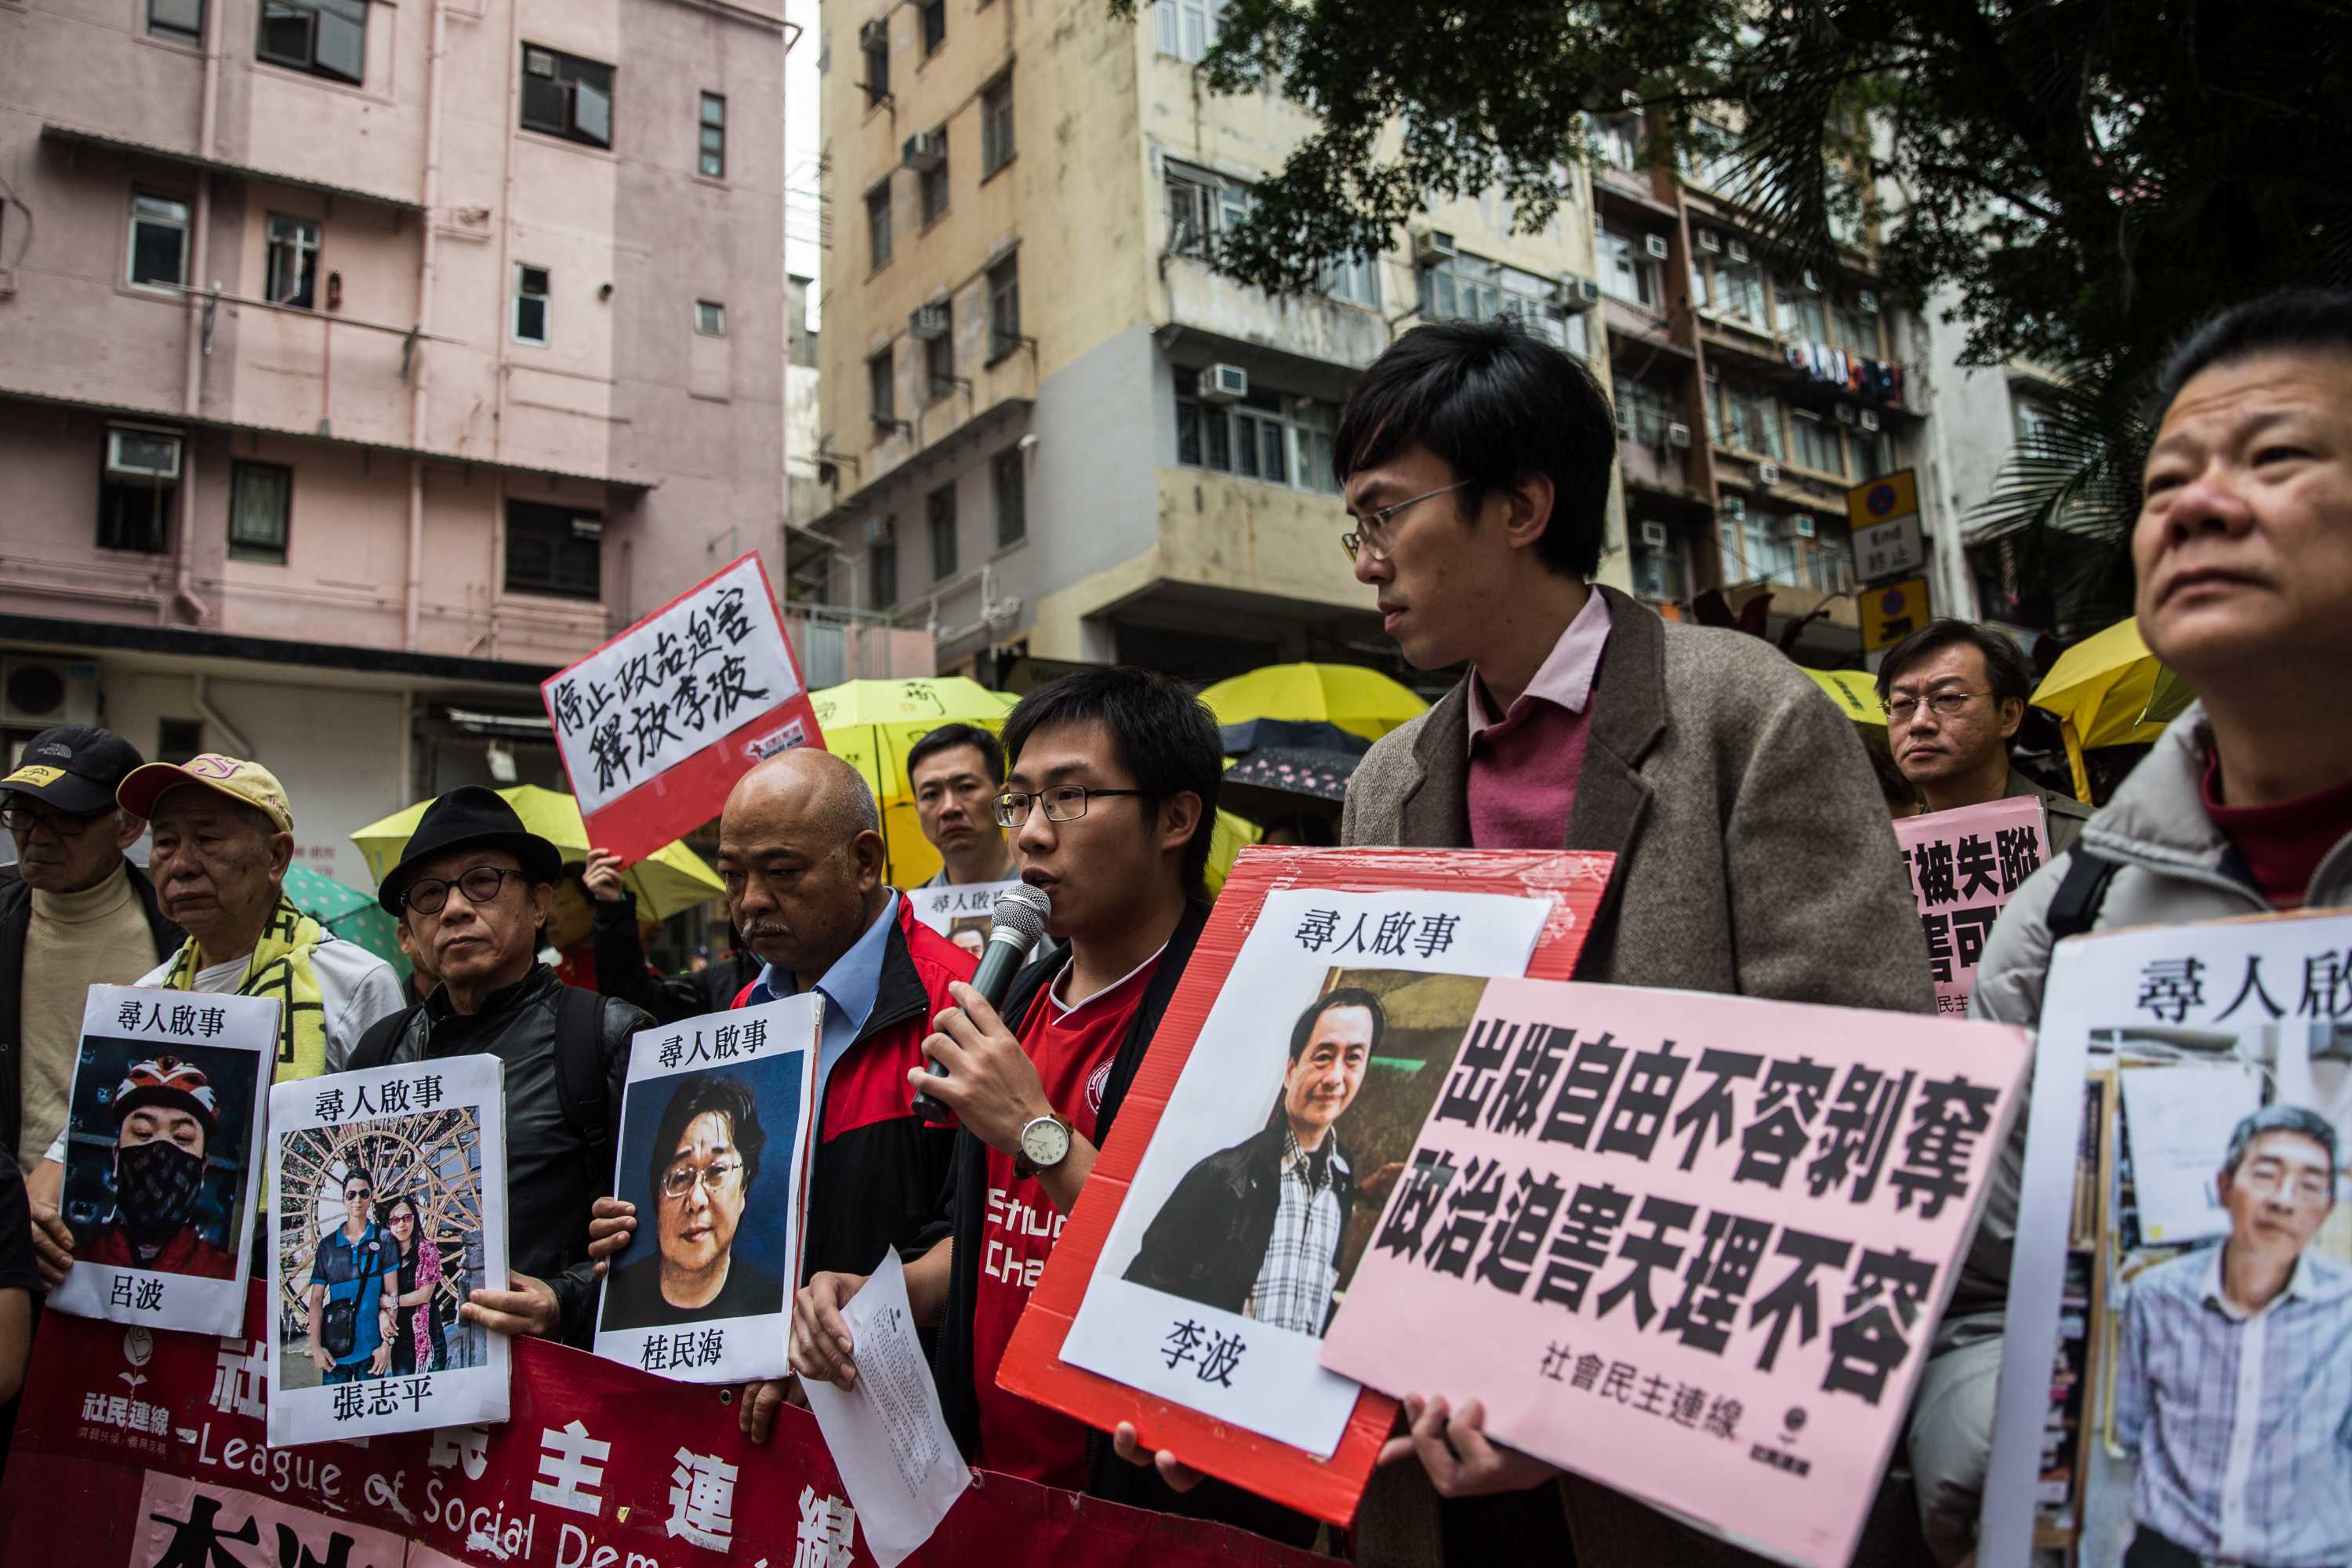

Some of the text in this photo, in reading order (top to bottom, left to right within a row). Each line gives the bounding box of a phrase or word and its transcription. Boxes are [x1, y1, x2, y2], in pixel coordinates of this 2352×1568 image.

[552, 586, 757, 738] 停止政治迫害
[587, 655, 769, 794] 釋放李波
[931, 890, 1004, 913] 尋人啟
[1295, 909, 1461, 957] 尋人啟事
[1922, 905, 2006, 983] 害可
[1937, 993, 1969, 1014] 民主
[2137, 947, 2352, 1022] 尋人啟
[118, 1000, 226, 1038] 尋人啟事
[659, 1018, 768, 1069] 尋人啟事
[314, 1074, 444, 1120] 尋人啟事
[1435, 1018, 2001, 1220] 出版自由不容剝奪
[111, 1275, 162, 1312] 呂波
[1375, 1147, 1939, 1408] 政治迫害天理不容
[641, 1328, 724, 1373] 桂民海
[1161, 1319, 1247, 1388] 李波
[82, 1392, 169, 1436] 社民連線
[332, 1376, 434, 1421] 張志平
[1541, 1341, 1744, 1440] 社會民主連線
[198, 1422, 343, 1496] League
[365, 1470, 407, 1507] of
[423, 1479, 536, 1560] Social
